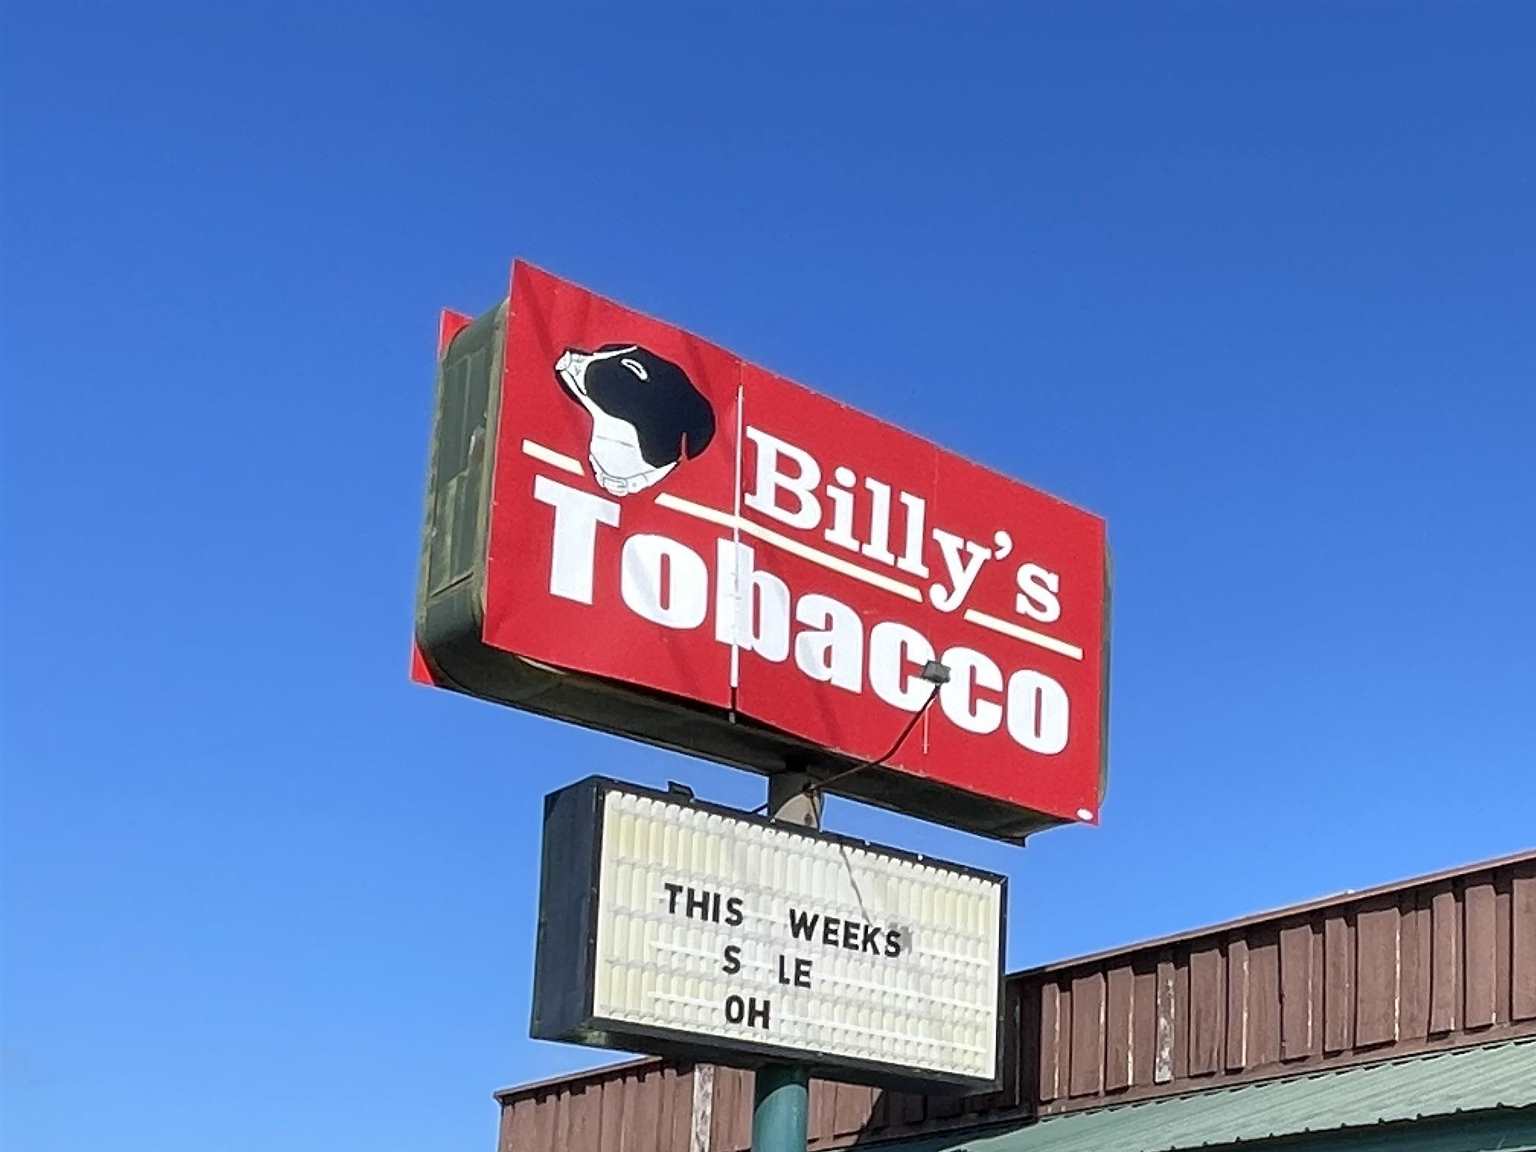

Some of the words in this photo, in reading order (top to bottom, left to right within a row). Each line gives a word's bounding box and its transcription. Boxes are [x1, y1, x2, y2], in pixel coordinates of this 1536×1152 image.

[745, 426, 1061, 623] Billy's
[533, 474, 1071, 756] Tobacco
[664, 883, 744, 927] THIS
[789, 908, 902, 958] WEEKS
[724, 994, 771, 1029] OH
